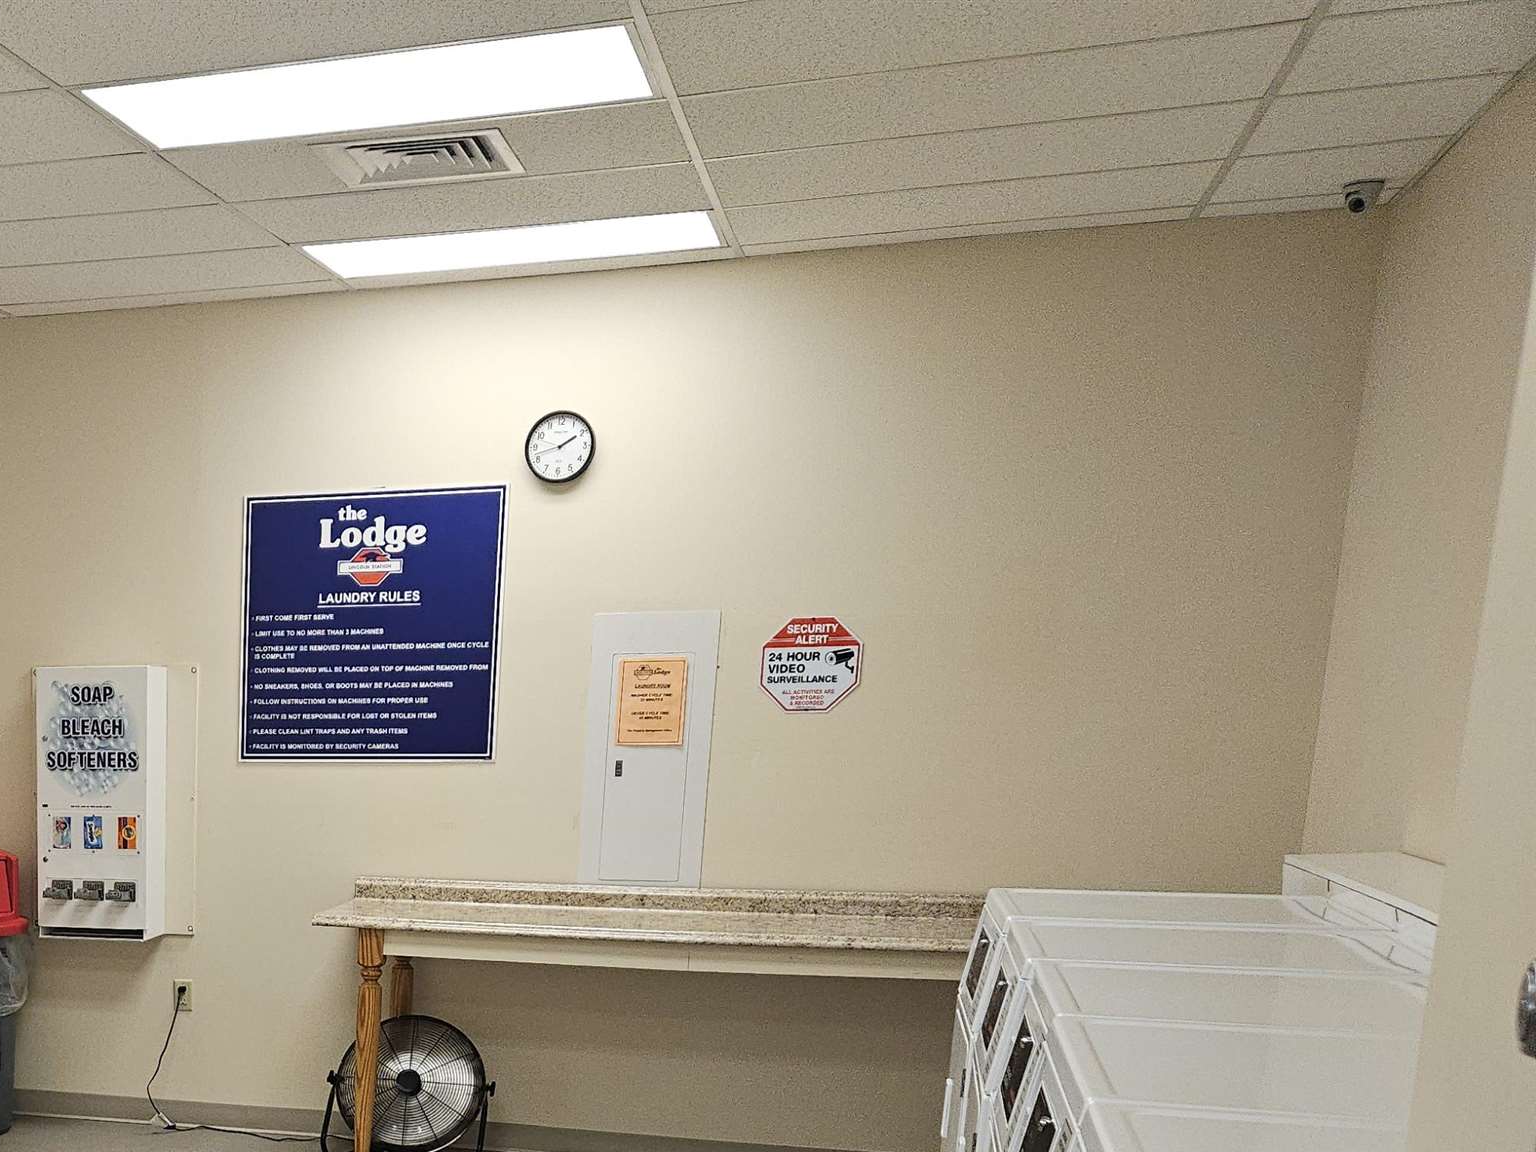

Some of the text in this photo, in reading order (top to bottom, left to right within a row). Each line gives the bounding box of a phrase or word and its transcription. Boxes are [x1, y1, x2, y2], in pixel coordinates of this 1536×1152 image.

[558, 417, 565, 425] 12
[537, 432, 544, 440] 10
[338, 505, 367, 520] the
[319, 516, 426, 552] Lodge
[319, 591, 420, 604] LAUNDRY RULES
[787, 623, 838, 633] SECURITY
[795, 635, 829, 644] ALERT
[768, 652, 820, 662] 24 HOUR
[768, 664, 805, 673] VIDEO
[767, 675, 838, 683] SURVEILLANCE
[71, 686, 114, 704] SOAP
[61, 718, 124, 738] BLEACH
[47, 752, 138, 769] SOFTENERS
